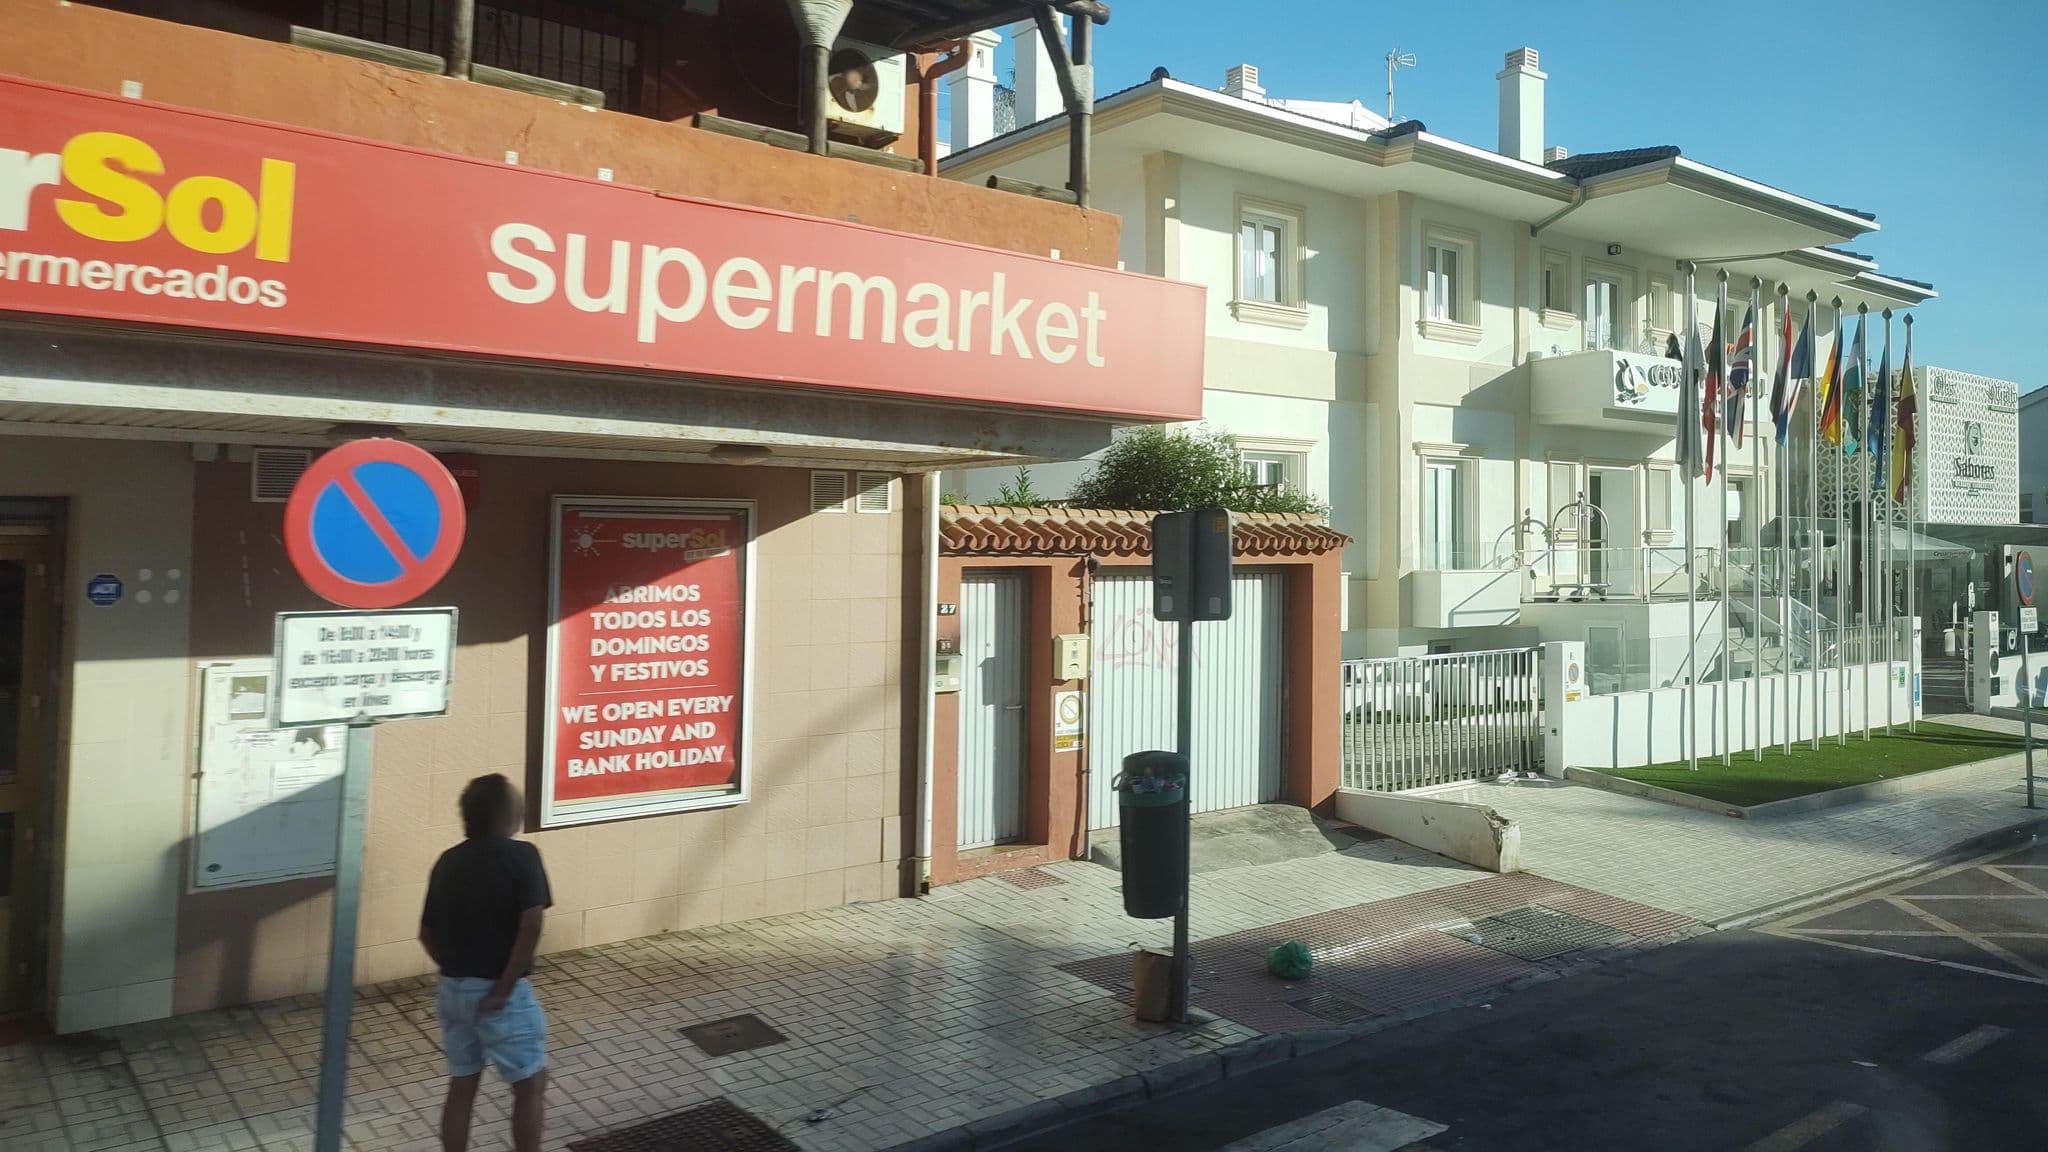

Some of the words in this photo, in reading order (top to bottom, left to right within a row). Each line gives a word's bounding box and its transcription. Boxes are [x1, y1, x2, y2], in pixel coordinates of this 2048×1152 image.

[0, 250, 287, 308] rmercados
[487, 222, 1106, 368] supermarket
[623, 528, 725, 551] superSol
[604, 585, 700, 603] ABRIMOS
[590, 612, 665, 630] TODOS
[671, 609, 711, 628] LOS
[941, 604, 956, 614] 27
[591, 634, 709, 657] DOMINGOS
[589, 664, 605, 682] Y
[611, 659, 709, 681] FESTIVOS
[561, 704, 598, 724] WE
[602, 699, 663, 722] OPEN
[667, 695, 733, 717] EVERY
[579, 725, 666, 750] SUNDAY
[670, 721, 716, 742] AND
[568, 752, 630, 777] BANK
[636, 745, 726, 771] HOLIDAY
